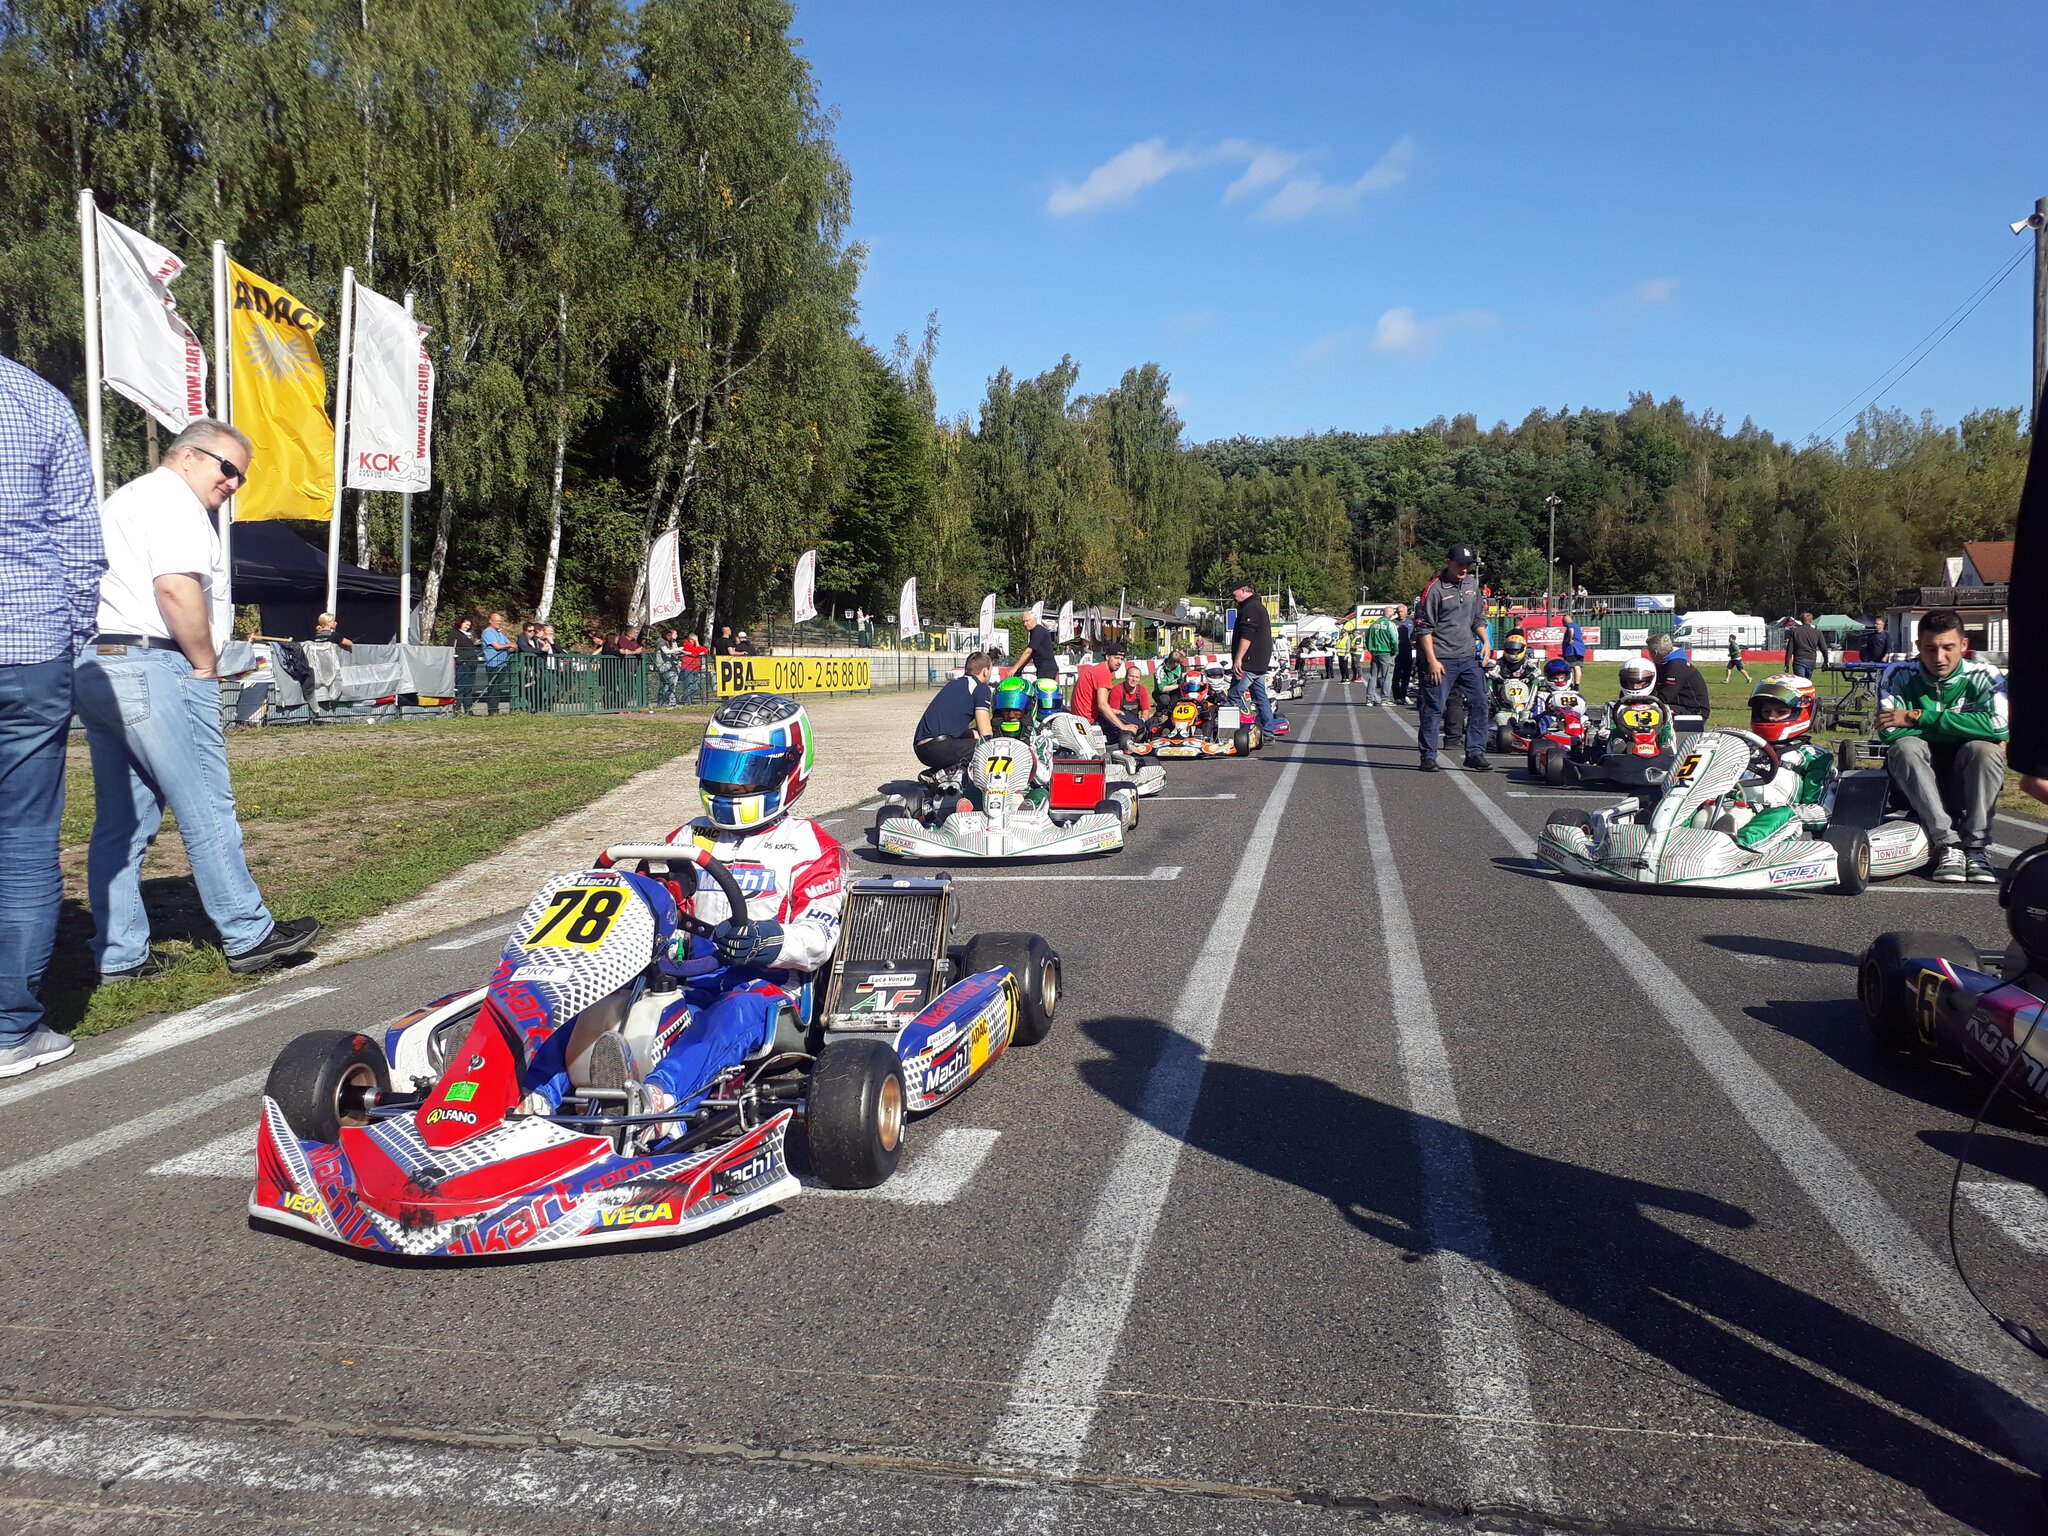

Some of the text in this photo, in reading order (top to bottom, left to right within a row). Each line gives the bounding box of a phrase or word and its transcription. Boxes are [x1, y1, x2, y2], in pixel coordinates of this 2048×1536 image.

[234, 280, 321, 330] ADAC
[359, 452, 401, 472] KCK
[721, 661, 755, 692] PBA
[774, 662, 805, 690] 0180
[815, 661, 822, 688] 2
[825, 662, 839, 688] 55
[842, 662, 854, 687] 88
[856, 661, 869, 686] 00
[1509, 688, 1523, 696] 37
[1176, 706, 1190, 714] 46
[987, 756, 1013, 773] 77
[1676, 754, 1702, 778] 5
[577, 877, 620, 887] Mach1
[804, 878, 840, 899] Mach1
[525, 889, 623, 945] 78
[516, 966, 556, 977] DKM
[888, 975, 915, 983] Voncken
[926, 1043, 969, 1092] Mach1
[426, 1108, 478, 1125] ALFANO
[283, 1191, 324, 1217] VEGA
[601, 1202, 674, 1227] VEGA
